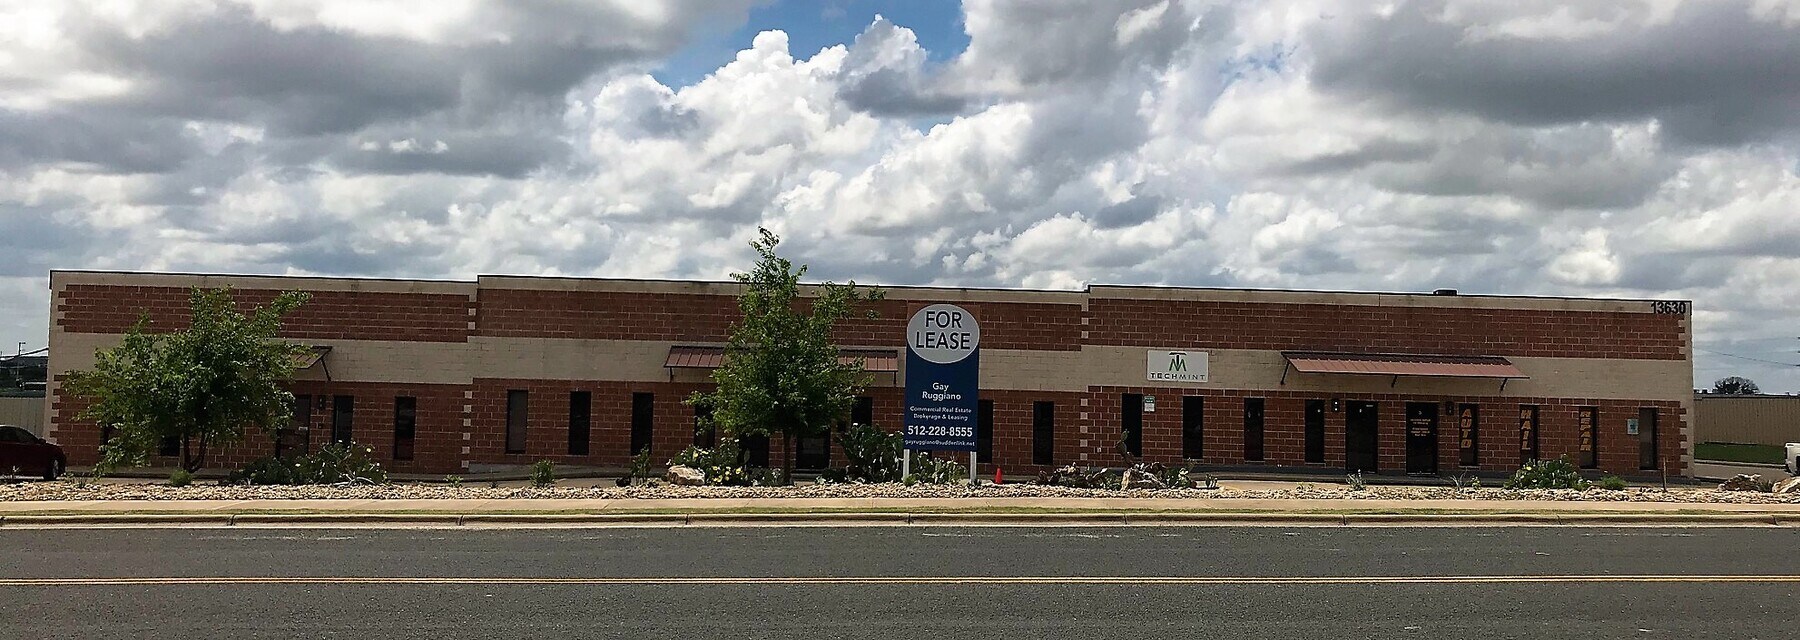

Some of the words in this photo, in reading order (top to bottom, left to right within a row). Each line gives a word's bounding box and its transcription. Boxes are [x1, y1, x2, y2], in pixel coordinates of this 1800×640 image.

[1651, 301, 1686, 314] 13630
[925, 310, 962, 329] FOR
[916, 331, 971, 350] LEASE
[1150, 372, 1206, 380] TECHMINT
[932, 382, 949, 391] Gay
[922, 391, 962, 401] Ruggiano
[907, 425, 973, 437] 512-228-8555
[1461, 409, 1472, 449] AUTO
[1521, 410, 1532, 450] HAIL
[1580, 411, 1591, 451] REPAIR
